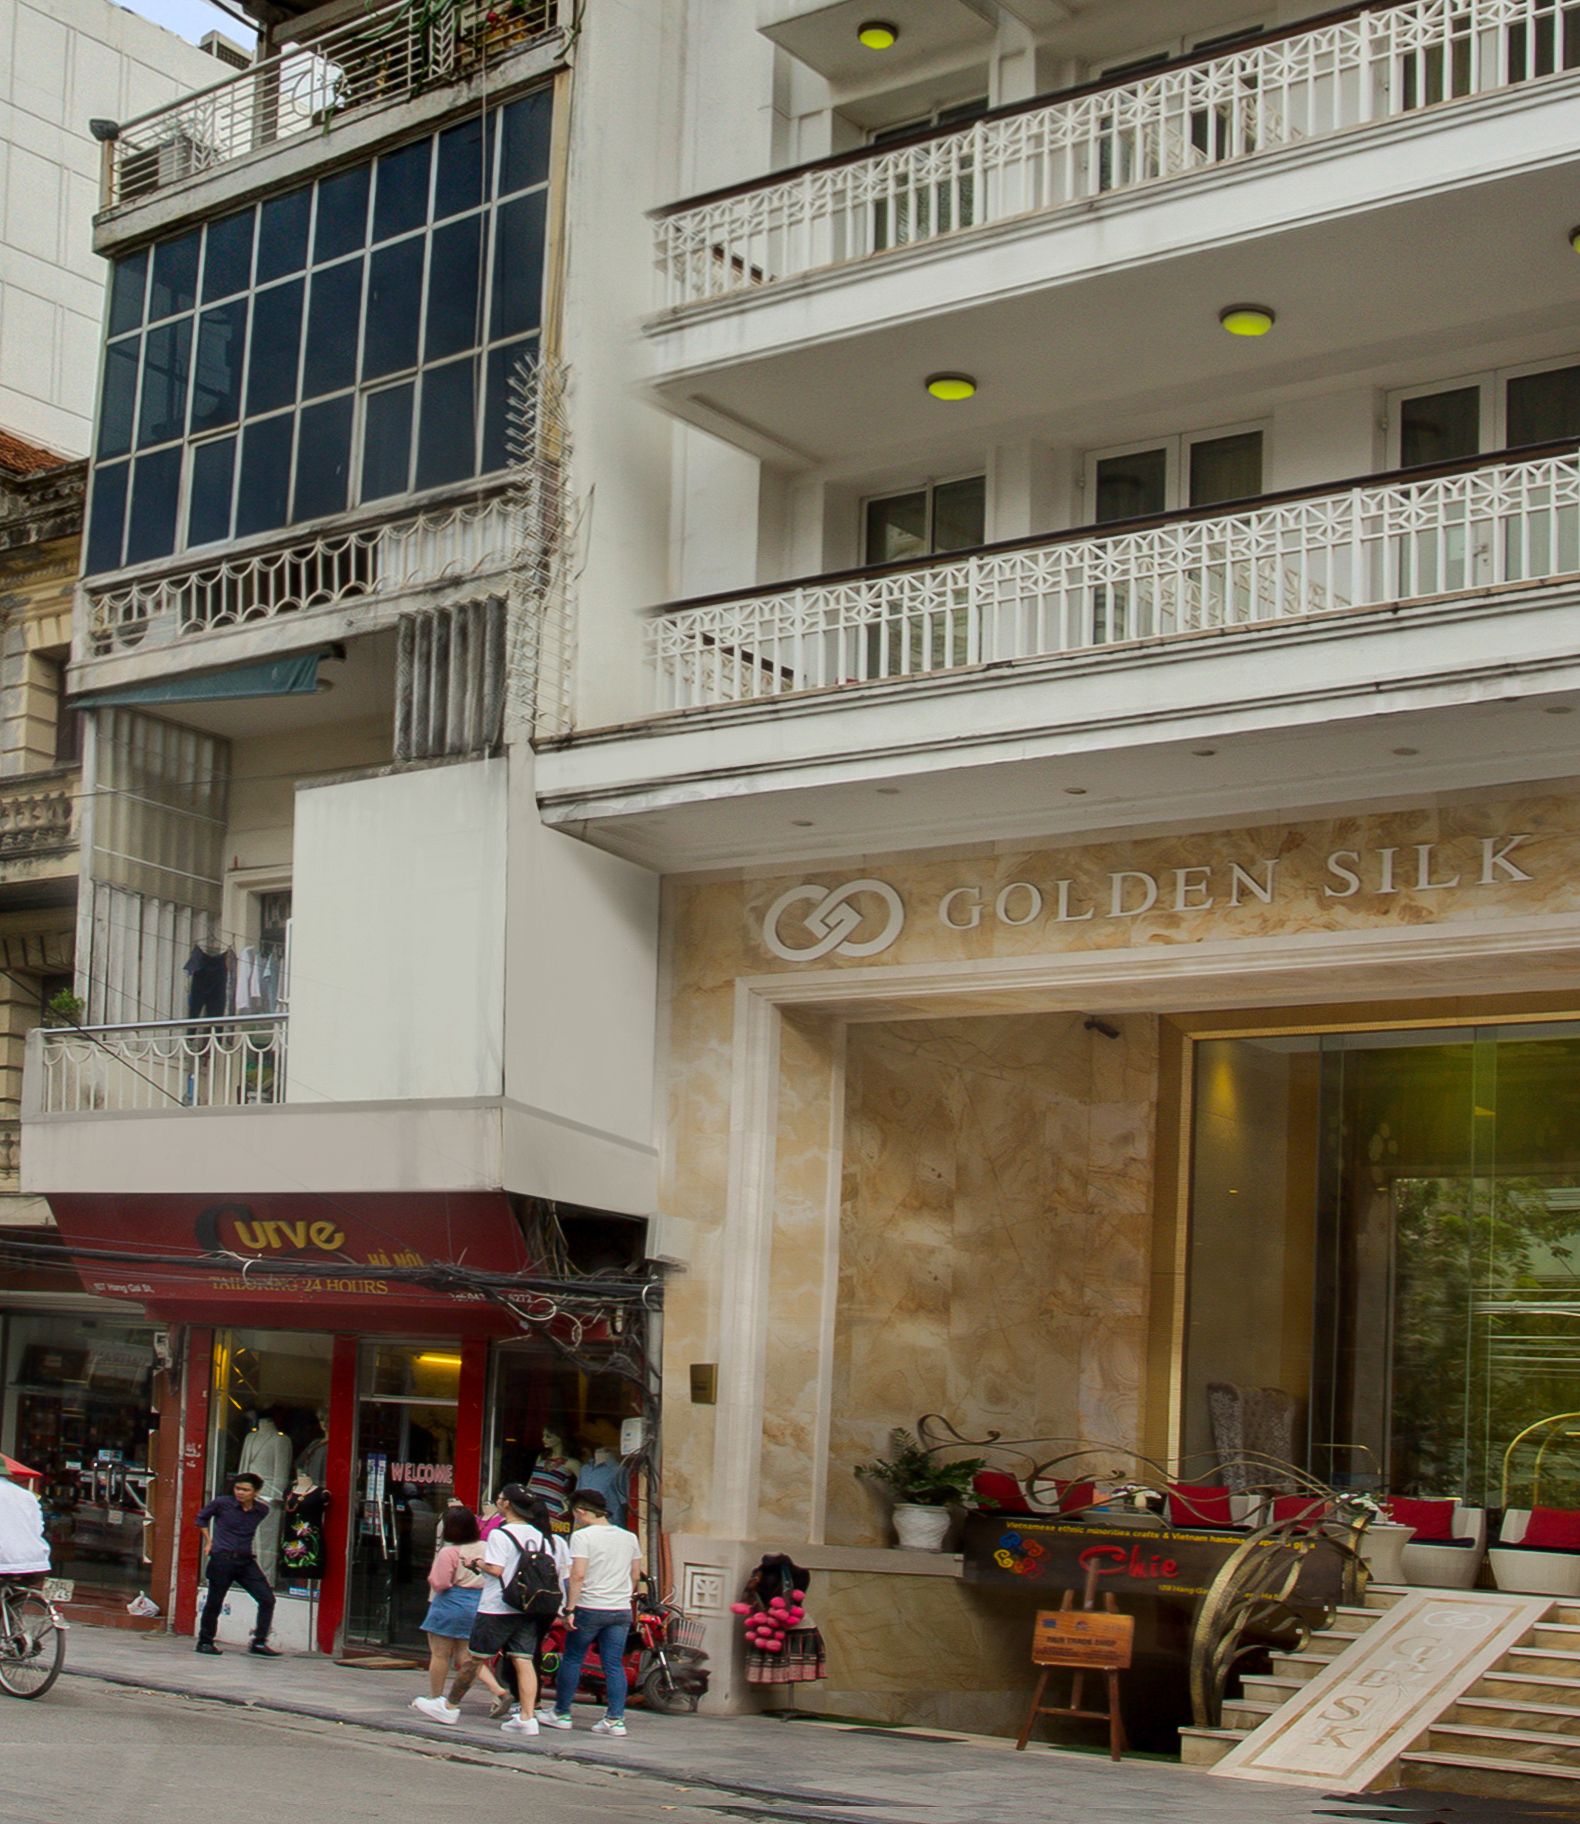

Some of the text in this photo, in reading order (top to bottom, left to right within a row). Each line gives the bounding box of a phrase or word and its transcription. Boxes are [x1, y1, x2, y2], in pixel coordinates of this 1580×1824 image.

[937, 856, 1281, 932] GOLDEN
[1323, 832, 1536, 899] SILK
[302, 1277, 322, 1292] 24
[326, 1279, 389, 1295] HOURS
[390, 1461, 454, 1485] WELCOME
[1005, 1520, 1056, 1532] Vietnamese
[1057, 1523, 1084, 1534] ethnic
[1086, 1525, 1131, 1537] minorities
[1132, 1528, 1160, 1540] crafts
[1171, 1532, 1208, 1543] Vietnam
